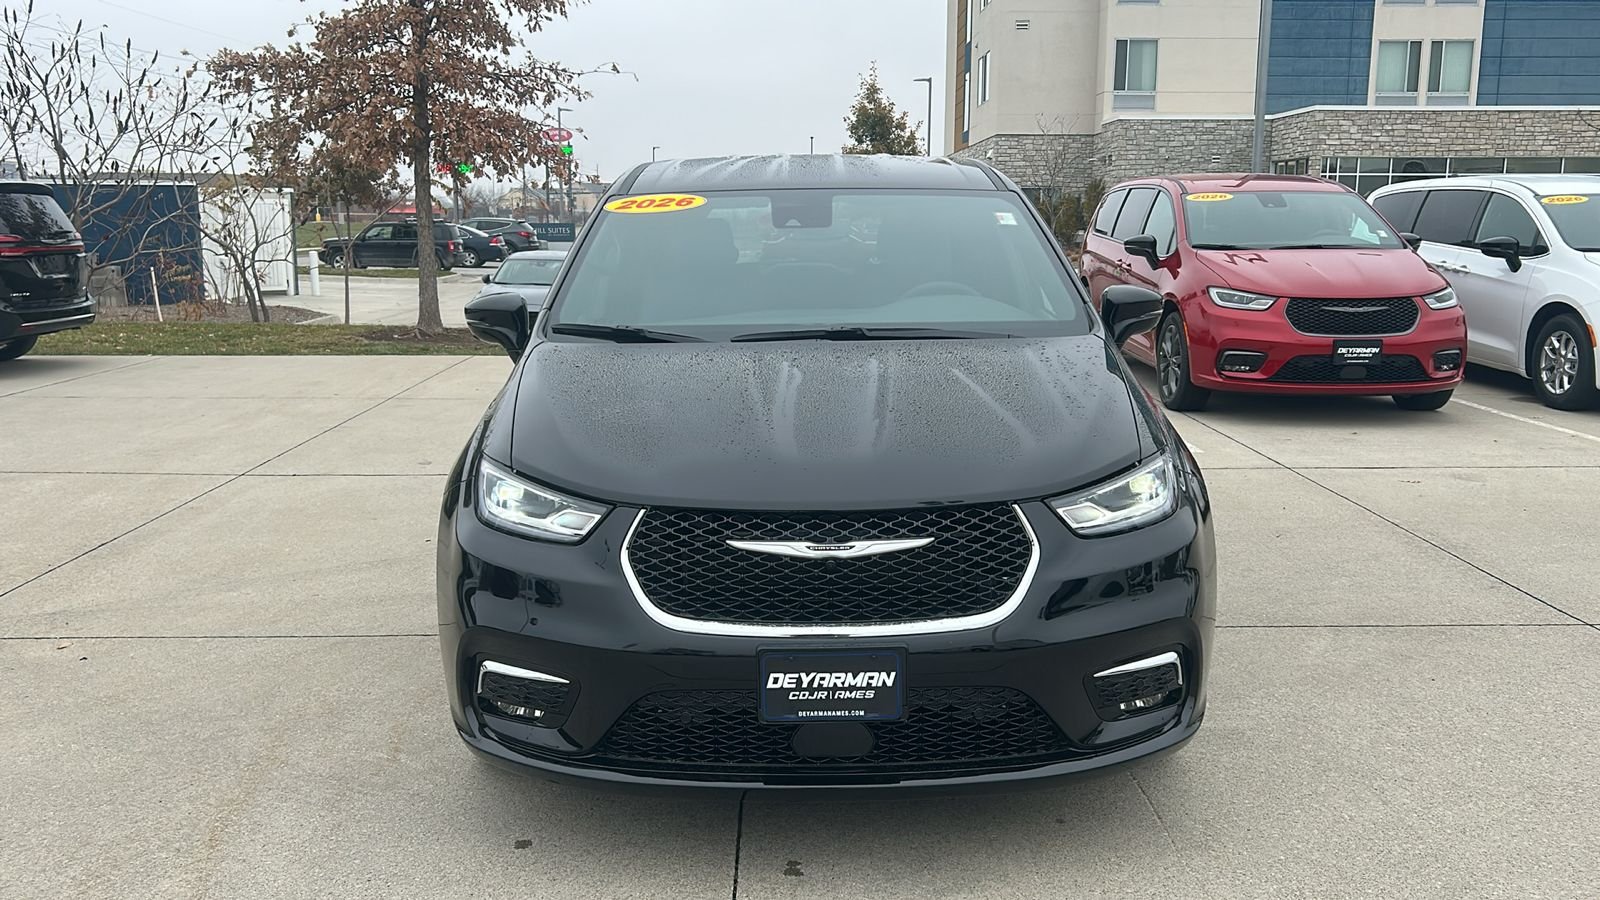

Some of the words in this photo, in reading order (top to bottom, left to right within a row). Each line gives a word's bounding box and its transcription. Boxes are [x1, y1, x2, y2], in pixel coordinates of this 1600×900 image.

[614, 197, 697, 210] 2026
[766, 671, 897, 689] DEYARMAN
[834, 690, 876, 699] AMES
